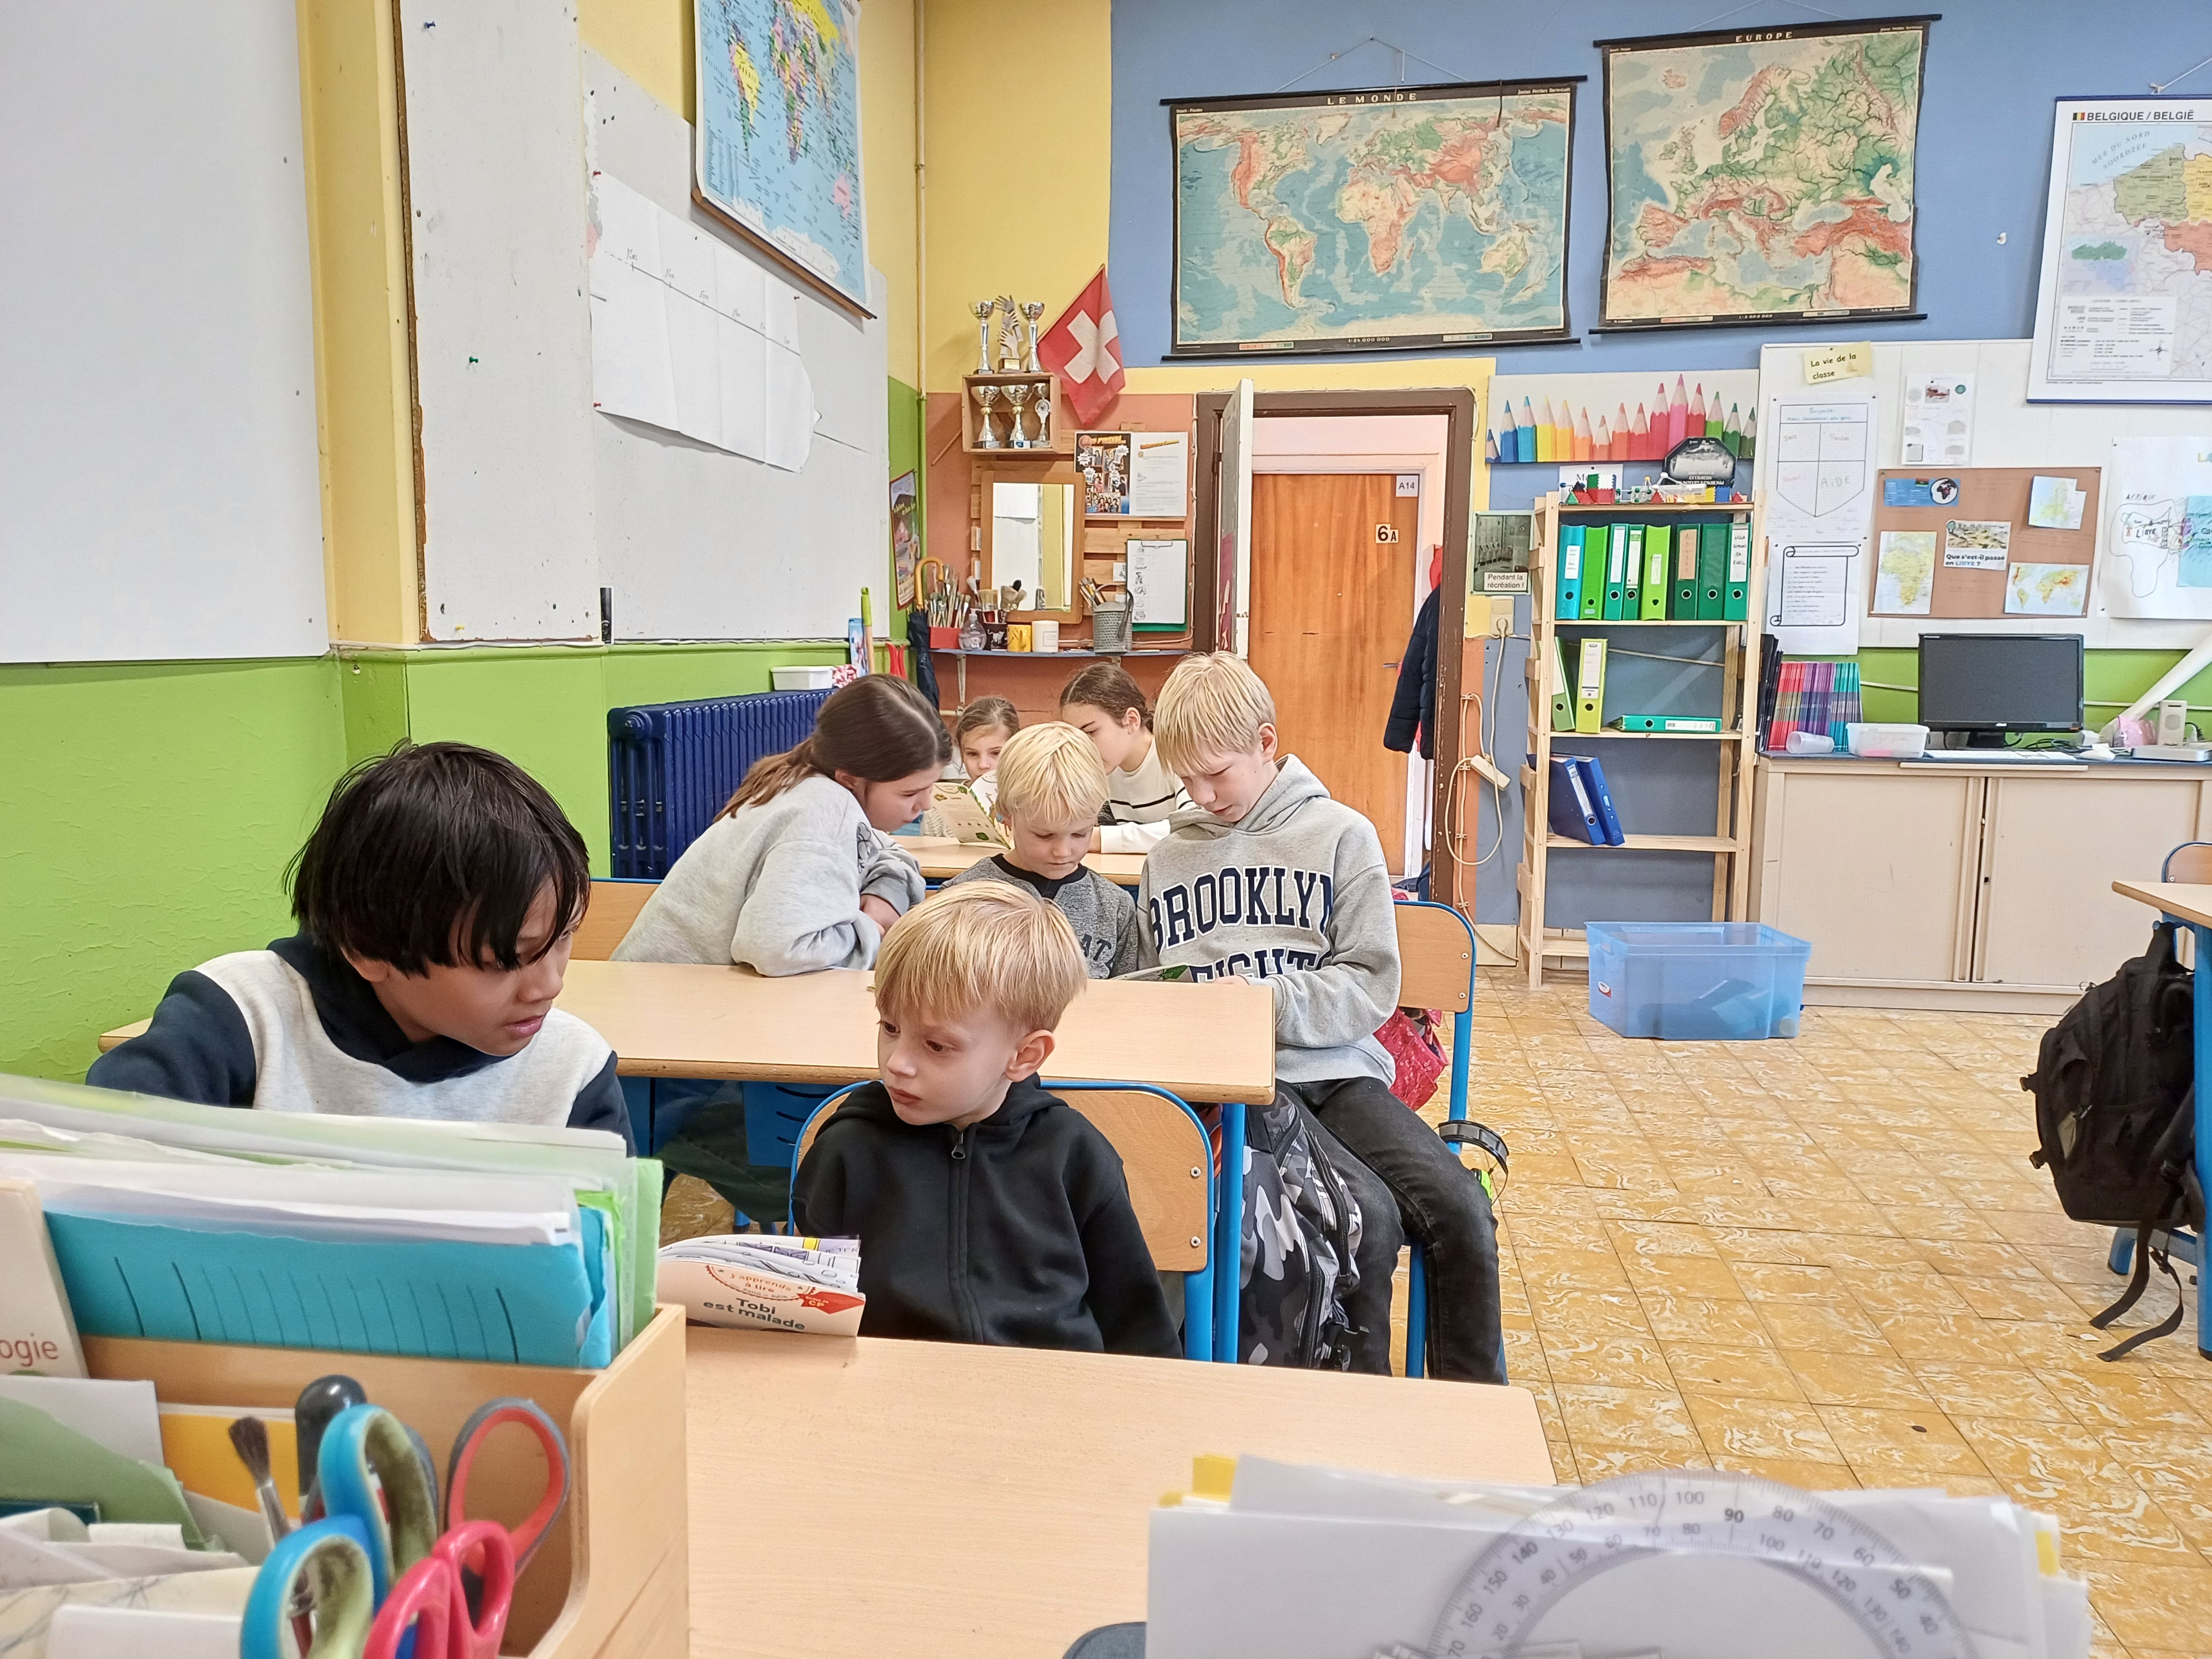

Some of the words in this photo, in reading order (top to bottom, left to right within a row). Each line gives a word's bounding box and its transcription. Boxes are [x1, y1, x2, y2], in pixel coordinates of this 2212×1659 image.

[1735, 32, 1792, 42] EUROPE
[1327, 97, 1347, 105] LE
[1355, 93, 1417, 103] MONDE
[2086, 111, 2144, 121] BELGIQUE
[2153, 109, 2194, 120] BELGIË
[2092, 150, 2108, 165] MER
[2110, 141, 2122, 152] DU
[2125, 131, 2150, 143] NORD
[1813, 371, 1835, 380] classe
[1378, 525, 1397, 542] 6A
[736, 1297, 776, 1314] Tobi
[703, 1301, 734, 1313] est
[738, 1308, 806, 1331] malade
[1629, 1493, 1657, 1510] 110
[1676, 1491, 1704, 1505] 100
[1585, 1503, 1614, 1521] 120
[1724, 1507, 1745, 1524] 90
[1772, 1505, 1794, 1522] 80
[1547, 1519, 1574, 1540] 130
[1682, 1522, 1700, 1535] 80
[1812, 1521, 1835, 1541] 70
[1760, 1533, 1785, 1551] 100
[1854, 1547, 1875, 1567] 60
[1483, 1570, 1507, 1594] 150
[1460, 1603, 1483, 1628] 160
